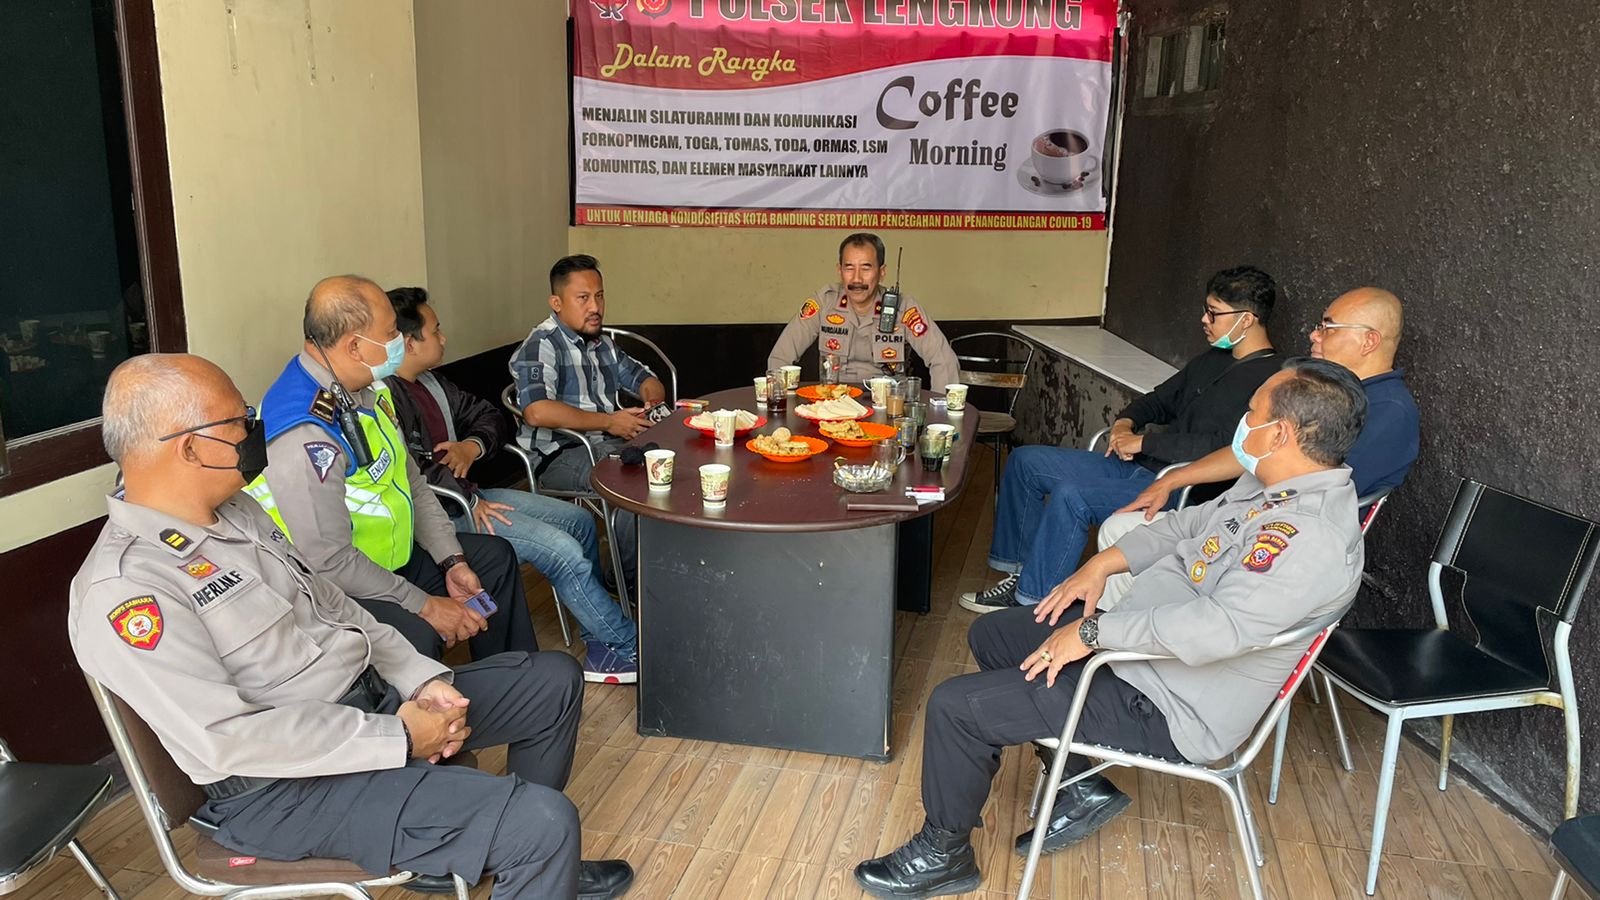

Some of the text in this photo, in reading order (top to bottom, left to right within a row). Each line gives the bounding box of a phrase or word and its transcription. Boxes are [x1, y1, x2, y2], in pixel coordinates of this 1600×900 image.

[863, 0, 1082, 30] LENGKONG
[601, 43, 796, 81] Dalam Rangka
[876, 76, 1019, 130] Coffee
[582, 107, 858, 128] MENJALIN SILATURAHMI DAN KOMUNIKASI
[582, 132, 888, 154] FORKOPIMCAM, TOGA, TOMAS, TODA, ORMAS, LSM
[909, 137, 1008, 171] Morning
[583, 158, 868, 178] KOMUNITAS, DAN ELEMEN MASYARAKAT LAINNYA
[587, 208, 1092, 229] UNTUK MENJAGA KONDUSIFITAS KOTA BANDUNG SERTA UPAYA PENCEGAHAN DAN PENANGGULANGAN COVID-19
[875, 334, 903, 343] POLRI
[192, 570, 243, 607] HERLAN.F
